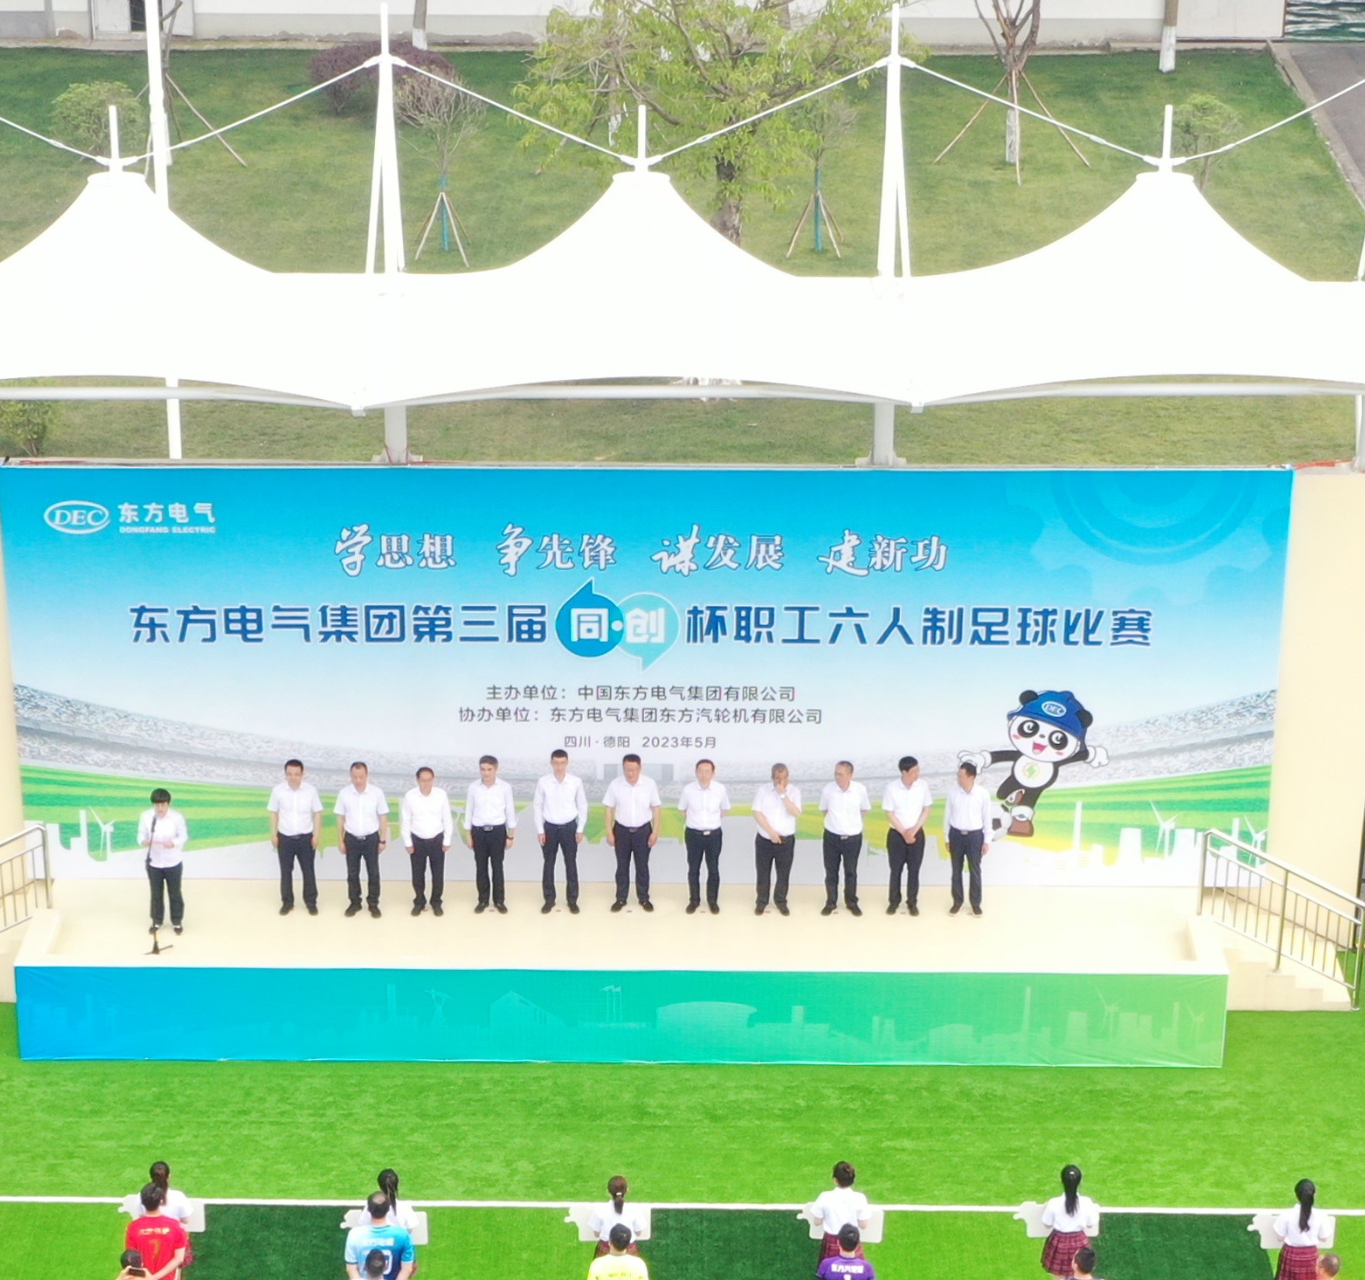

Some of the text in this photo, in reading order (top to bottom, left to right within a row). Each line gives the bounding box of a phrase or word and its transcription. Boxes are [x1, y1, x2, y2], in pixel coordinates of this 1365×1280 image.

[53, 508, 106, 527] DEC
[118, 502, 216, 524] 东方电气
[119, 526, 217, 535] DONGFANG ELECTRIC
[335, 523, 949, 577] 学思想 争先锋 谋发展 建新功
[129, 604, 547, 644] 东方电气集团第三届
[686, 605, 1153, 647] 杯职工六人制足球比赛
[485, 685, 796, 702] 主办单位：中国东方电气集团有限公司
[641, 735, 718, 749] 2023年5月
